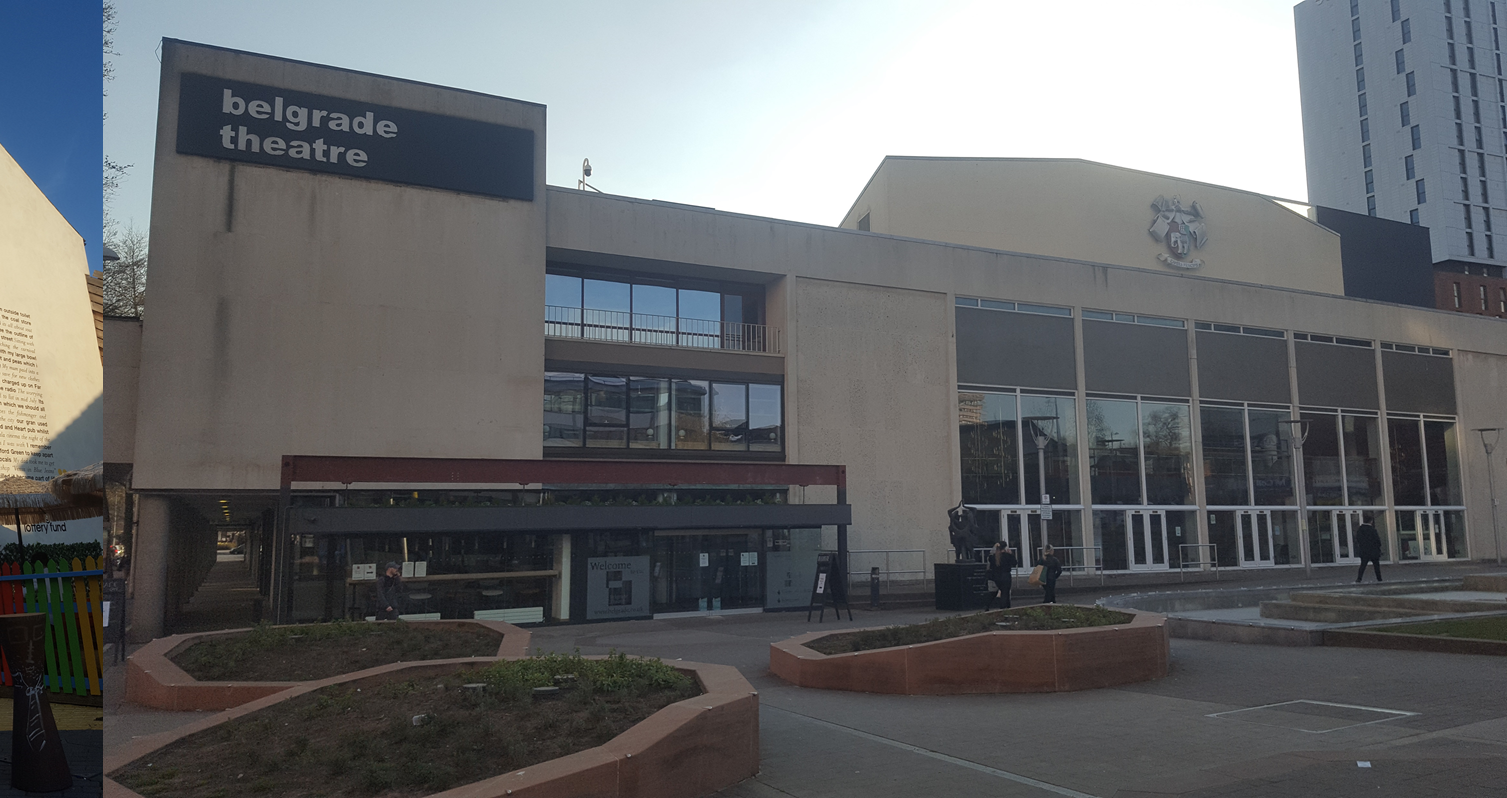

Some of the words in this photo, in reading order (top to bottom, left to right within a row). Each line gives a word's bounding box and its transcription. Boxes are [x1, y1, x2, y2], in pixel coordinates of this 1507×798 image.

[221, 87, 400, 140] belgrade
[219, 122, 370, 168] theatre
[50, 523, 67, 532] fund
[590, 561, 631, 570] Welcome
